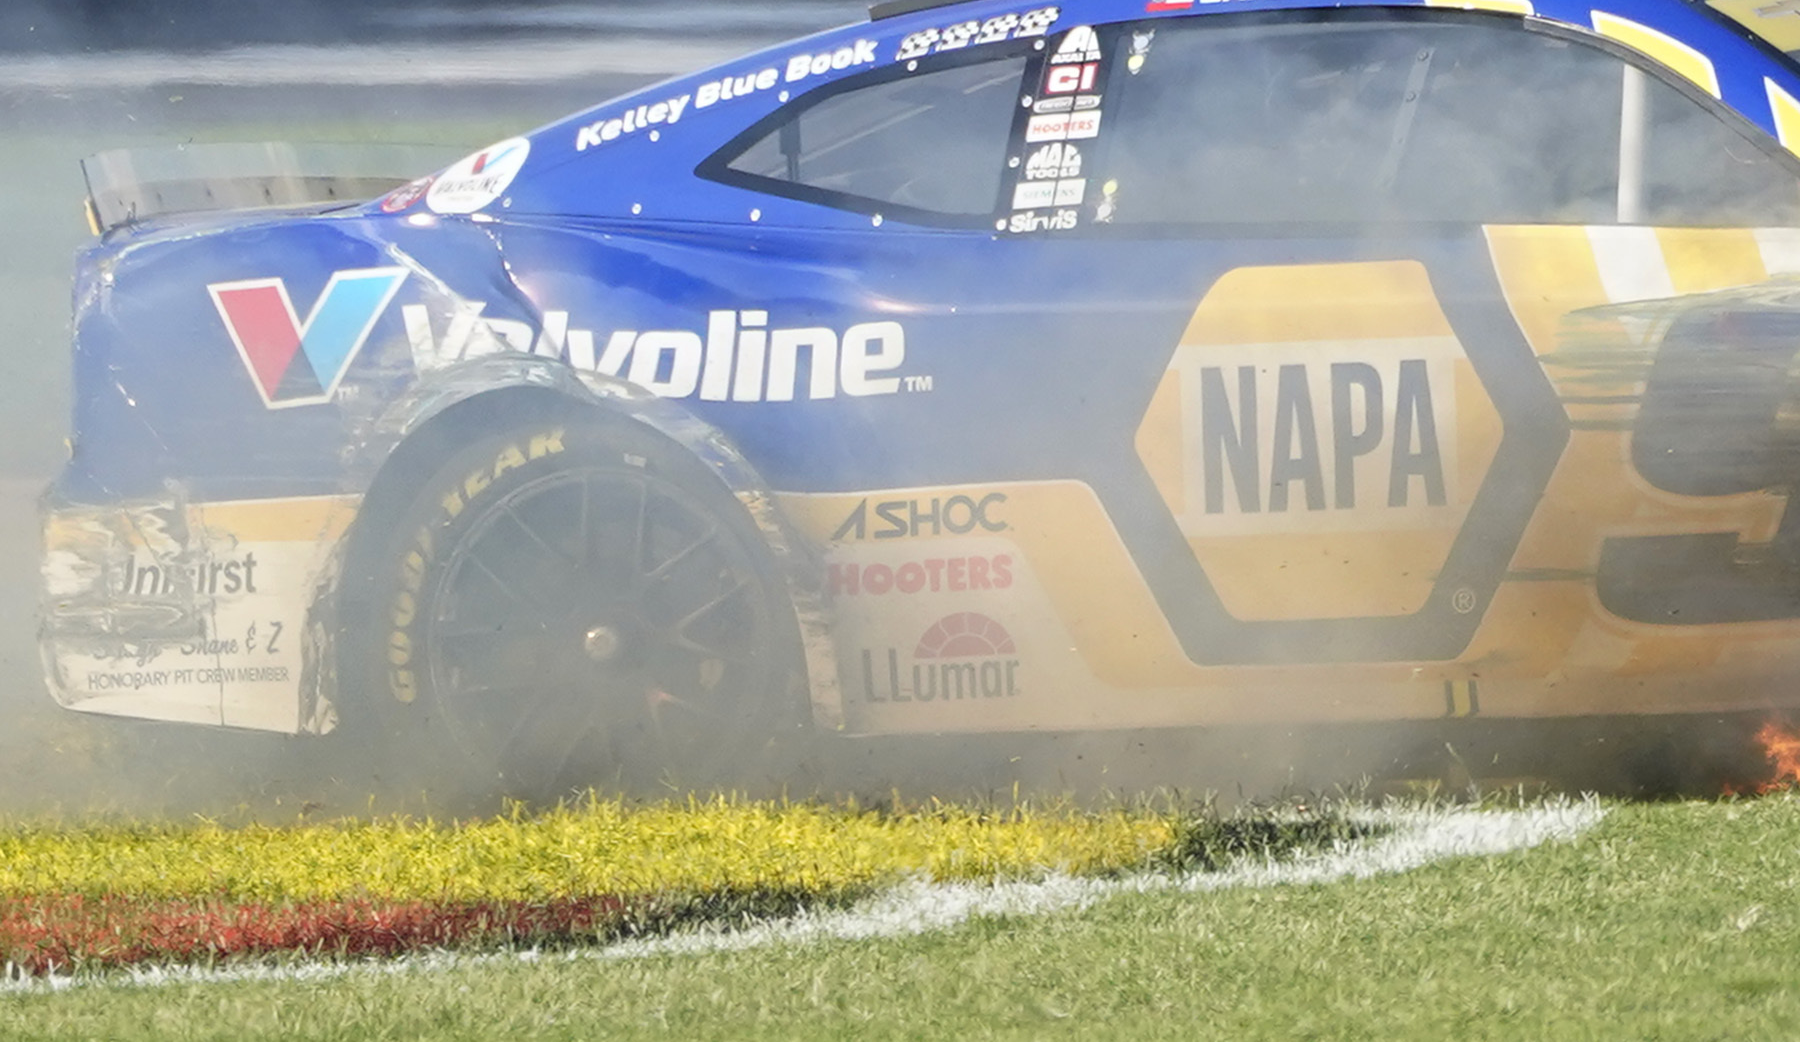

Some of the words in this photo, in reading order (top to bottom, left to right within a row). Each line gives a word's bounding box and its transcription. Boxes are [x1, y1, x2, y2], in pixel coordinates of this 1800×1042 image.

[575, 94, 691, 152] Kelley
[694, 67, 780, 111] Blue
[784, 39, 878, 83] Book
[1032, 119, 1094, 135] HOOTERS
[1026, 142, 1082, 170] MAC
[1026, 166, 1081, 181] TOOLS
[1024, 188, 1076, 199] SIEMNS
[402, 302, 906, 402] Valvoline
[1202, 358, 1448, 514] NAPA
[826, 553, 1014, 597] HOOTERS
[173, 668, 195, 685] PIT
[196, 667, 237, 685] CREW
[237, 665, 290, 683] MEMBER
